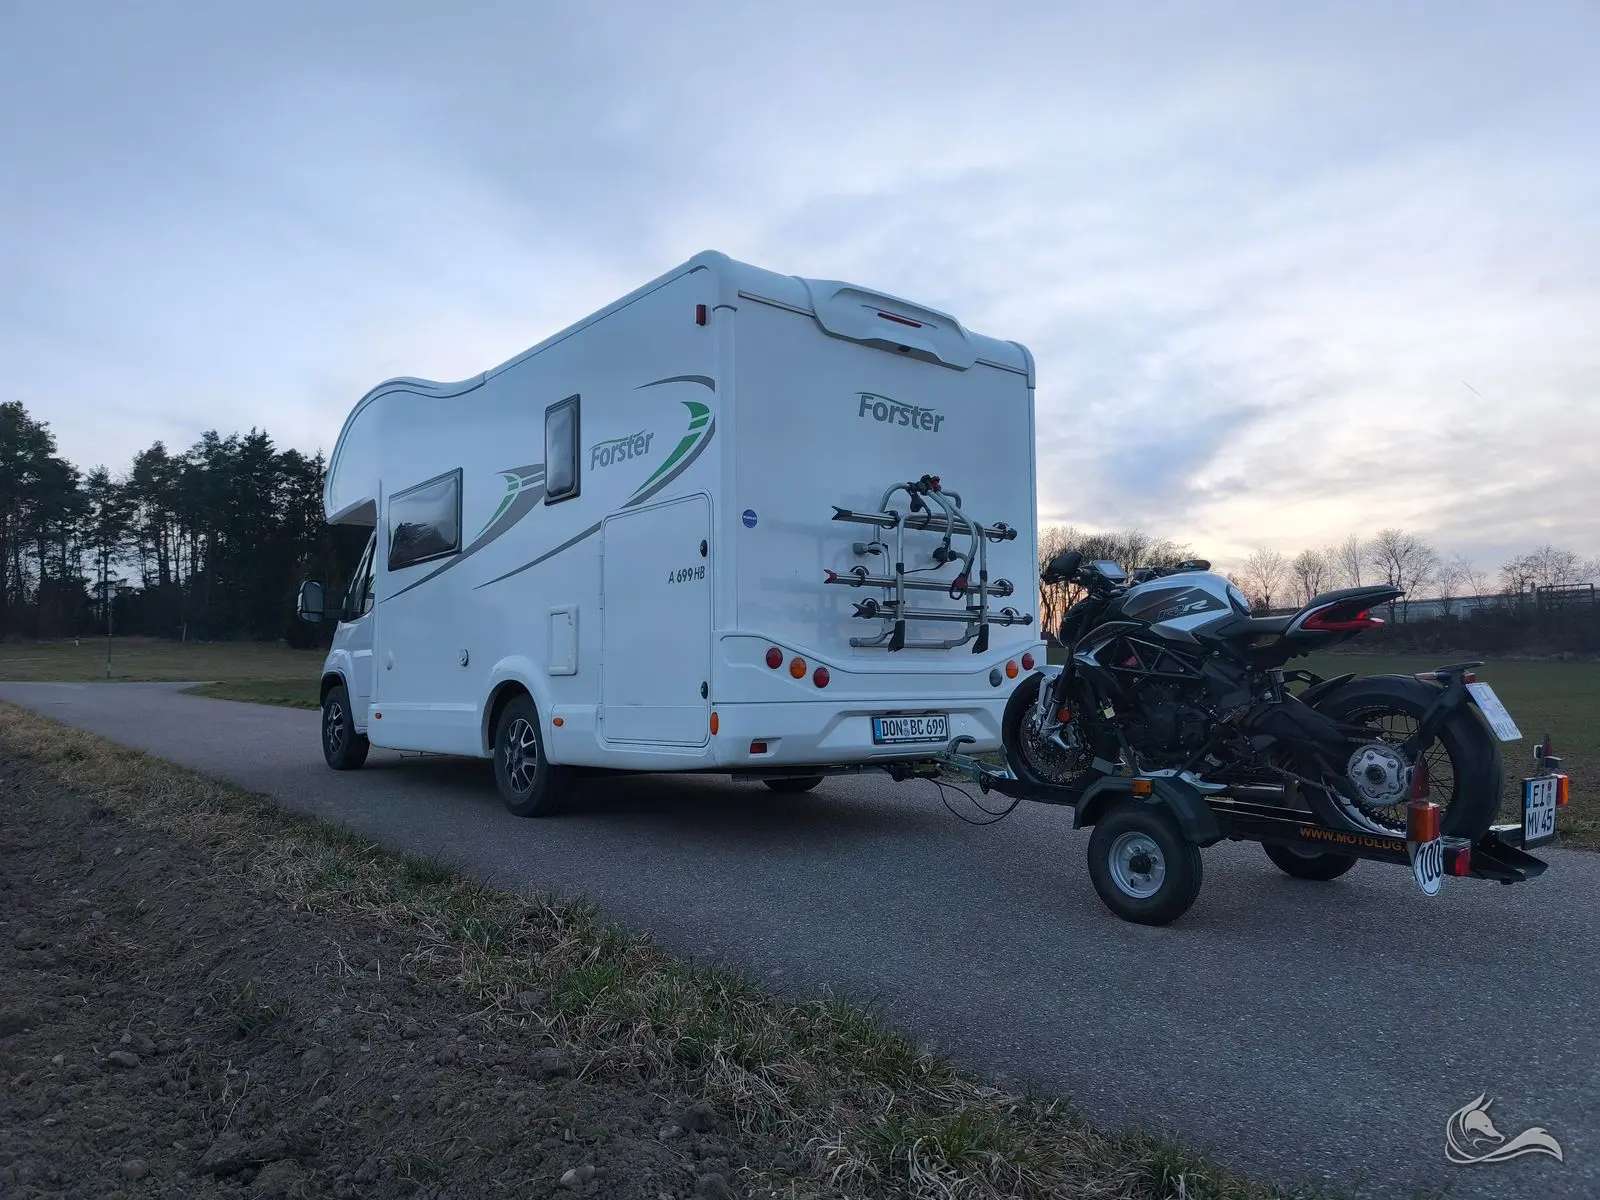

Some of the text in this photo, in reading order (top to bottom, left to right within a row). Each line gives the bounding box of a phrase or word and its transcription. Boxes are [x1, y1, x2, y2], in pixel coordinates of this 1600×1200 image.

[859, 394, 945, 433] Forster
[590, 432, 654, 471] Forster
[667, 565, 705, 584] A 699 HB
[881, 719, 945, 737] DON BC 699
[1532, 783, 1545, 808] EI
[1527, 807, 1554, 836] MV 45
[1300, 825, 1408, 853] WWW.MOTOLUG.
[1419, 838, 1441, 885] 100
